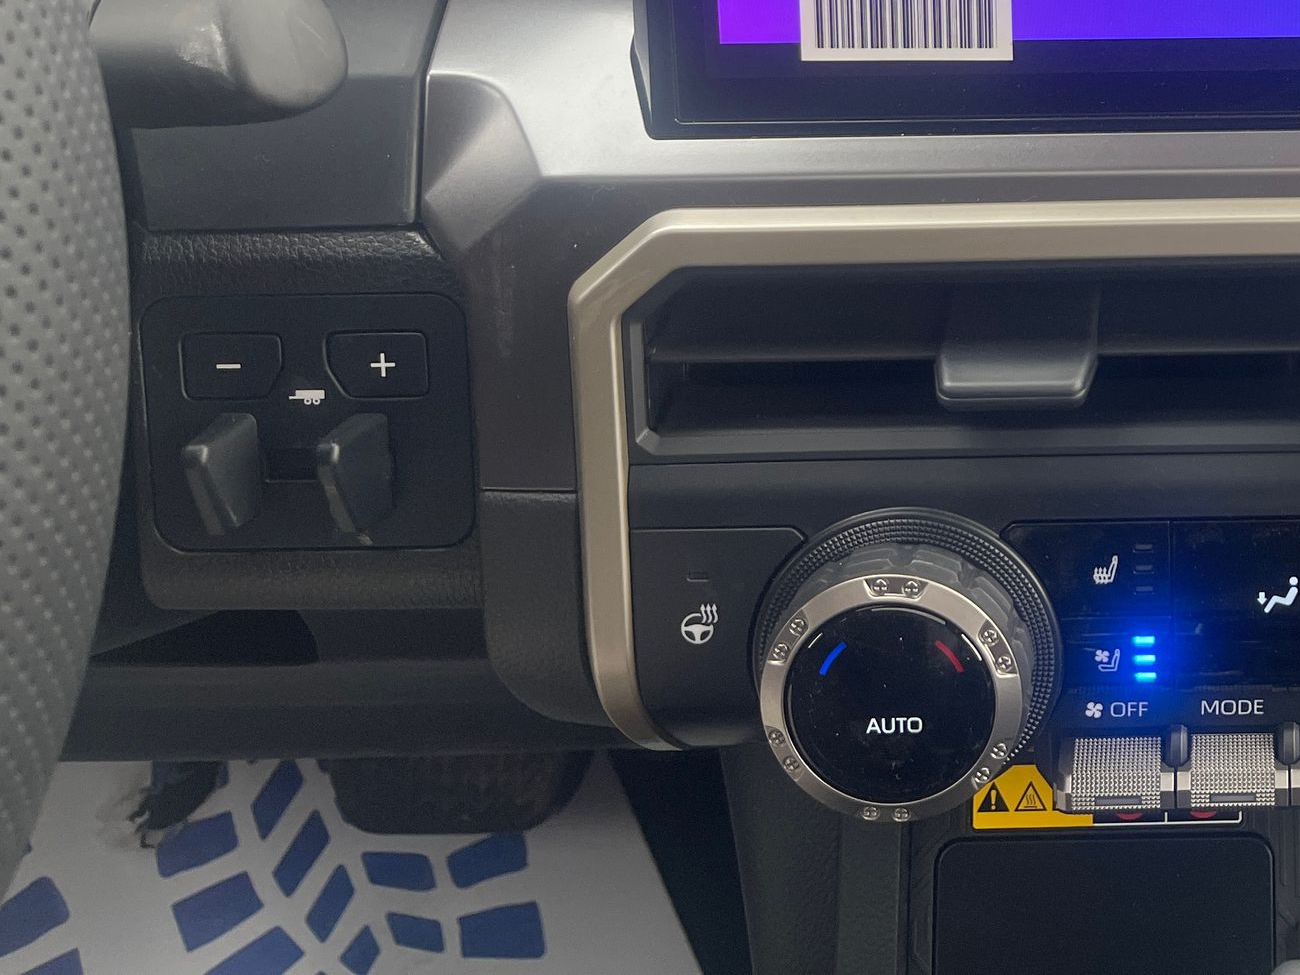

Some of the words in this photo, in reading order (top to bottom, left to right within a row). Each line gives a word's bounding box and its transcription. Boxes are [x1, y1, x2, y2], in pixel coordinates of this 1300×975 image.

[1110, 701, 1149, 718] OFF
[1201, 699, 1265, 716] MODE
[865, 716, 924, 735] AUTO
